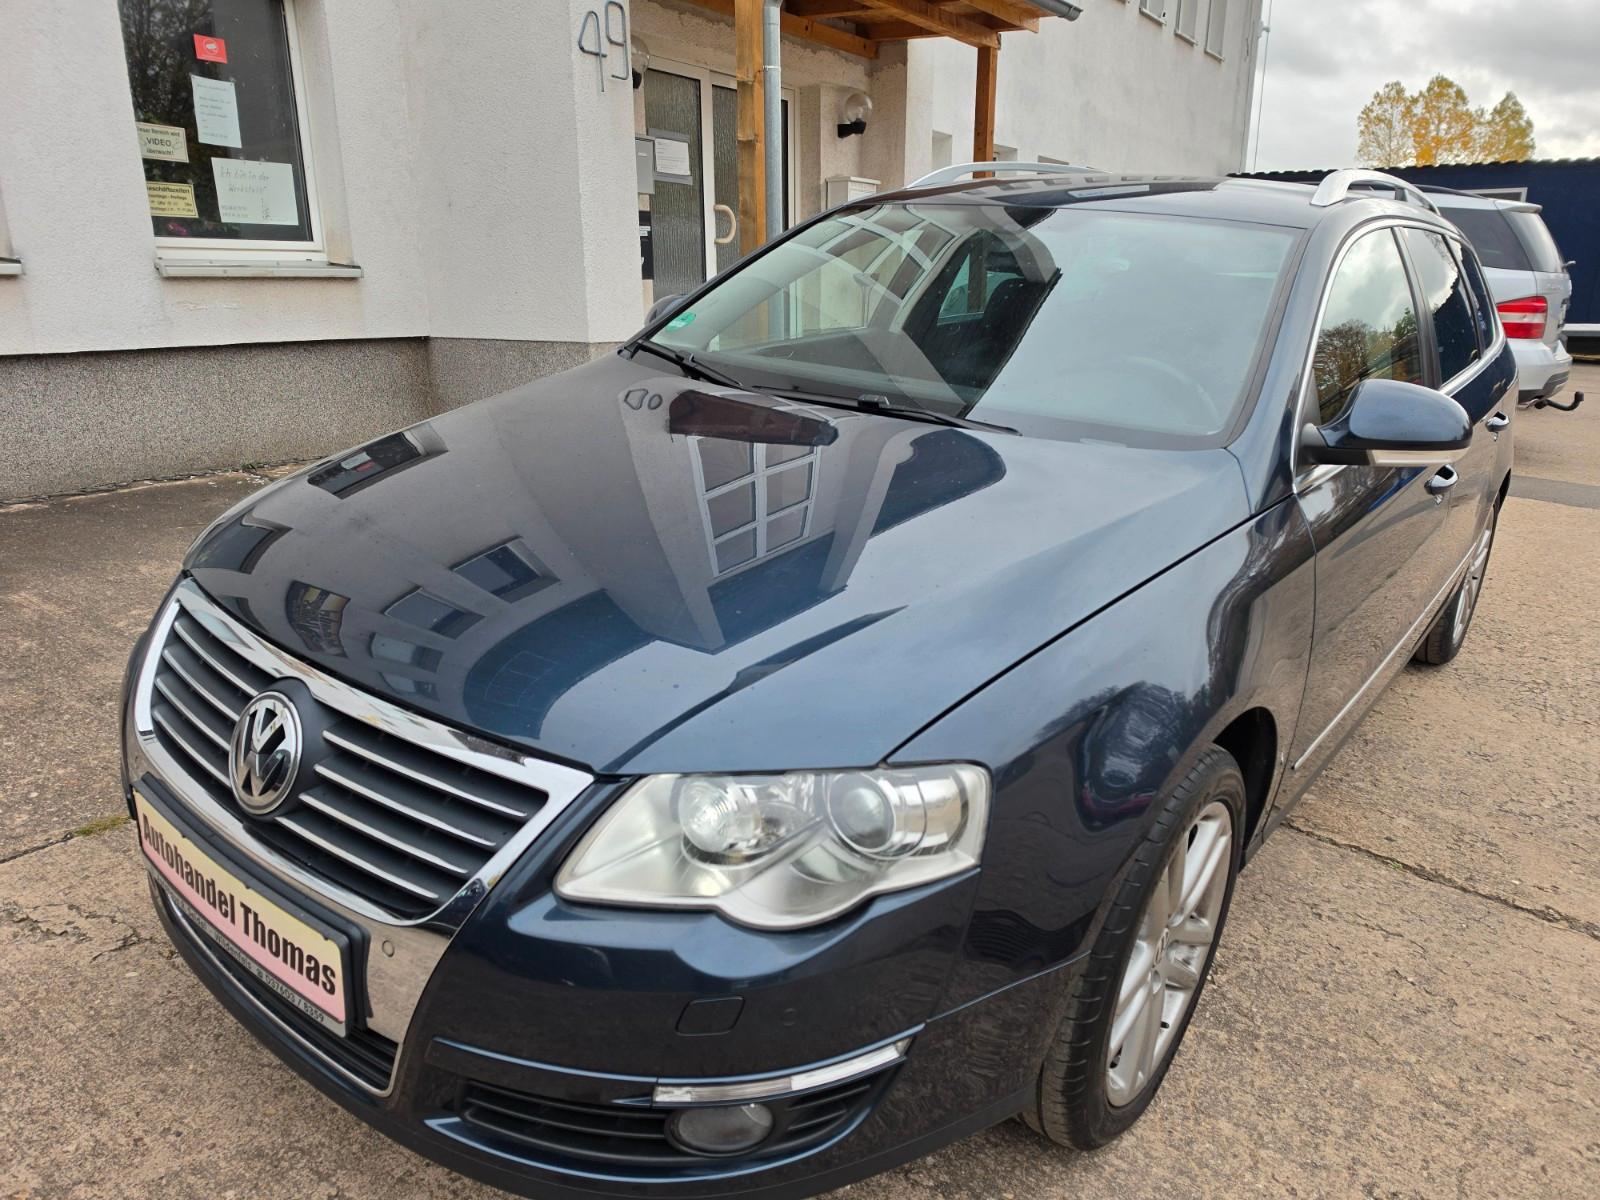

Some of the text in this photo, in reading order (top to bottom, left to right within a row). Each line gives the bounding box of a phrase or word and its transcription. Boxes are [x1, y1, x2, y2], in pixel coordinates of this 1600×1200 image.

[577, 0, 630, 92] 49
[146, 136, 172, 147] VIDEO
[147, 186, 190, 194] eschäftszeiten
[142, 812, 236, 927] Autohandel
[240, 902, 336, 996] Thomas
